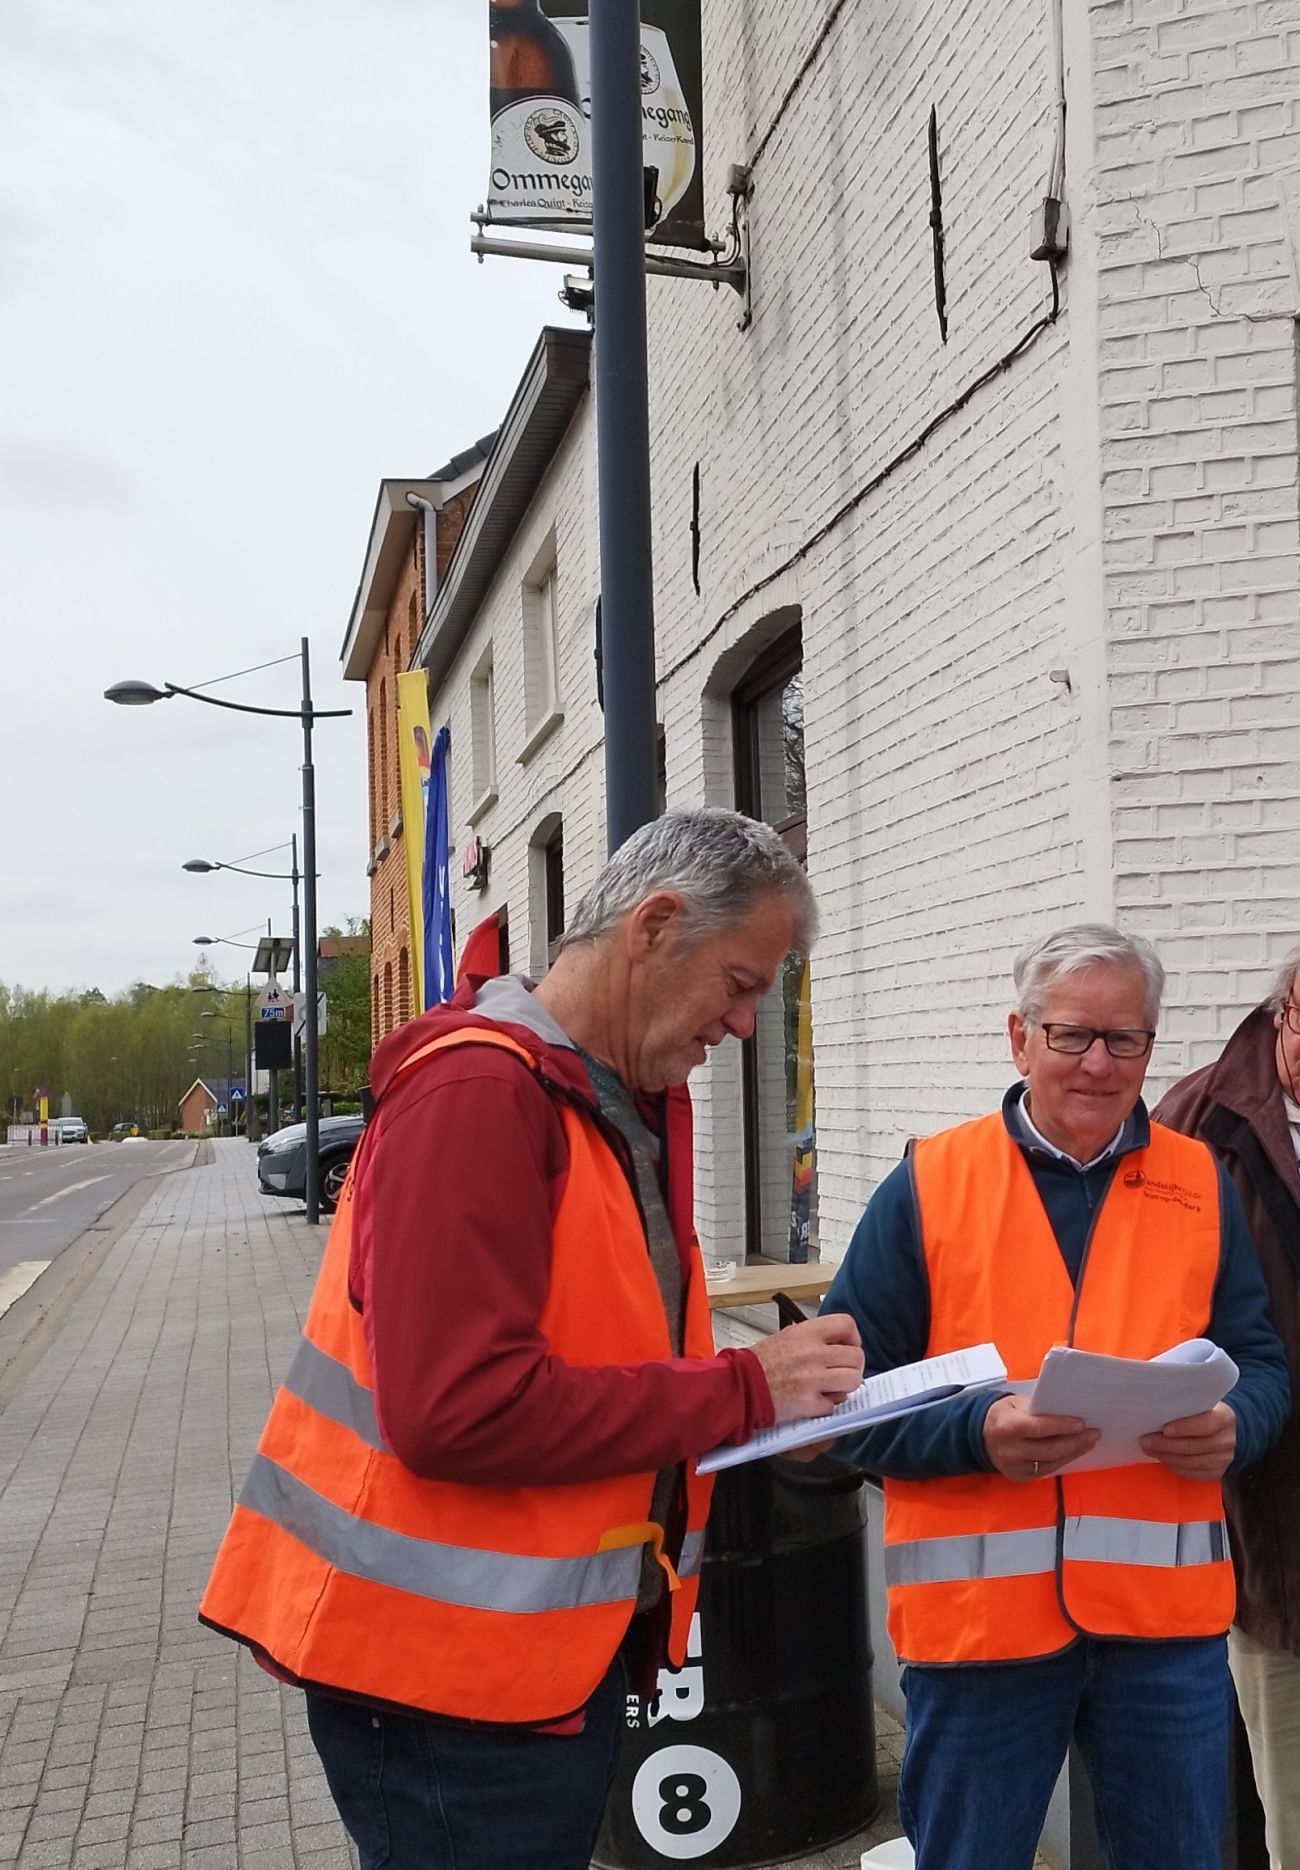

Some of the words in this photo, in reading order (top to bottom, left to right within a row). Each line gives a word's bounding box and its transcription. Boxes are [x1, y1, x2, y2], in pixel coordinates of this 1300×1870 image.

[492, 168, 592, 197] Ommega
[537, 198, 566, 209] Quint
[262, 1008, 284, 1018] 75m
[658, 1773, 712, 1836] 8
